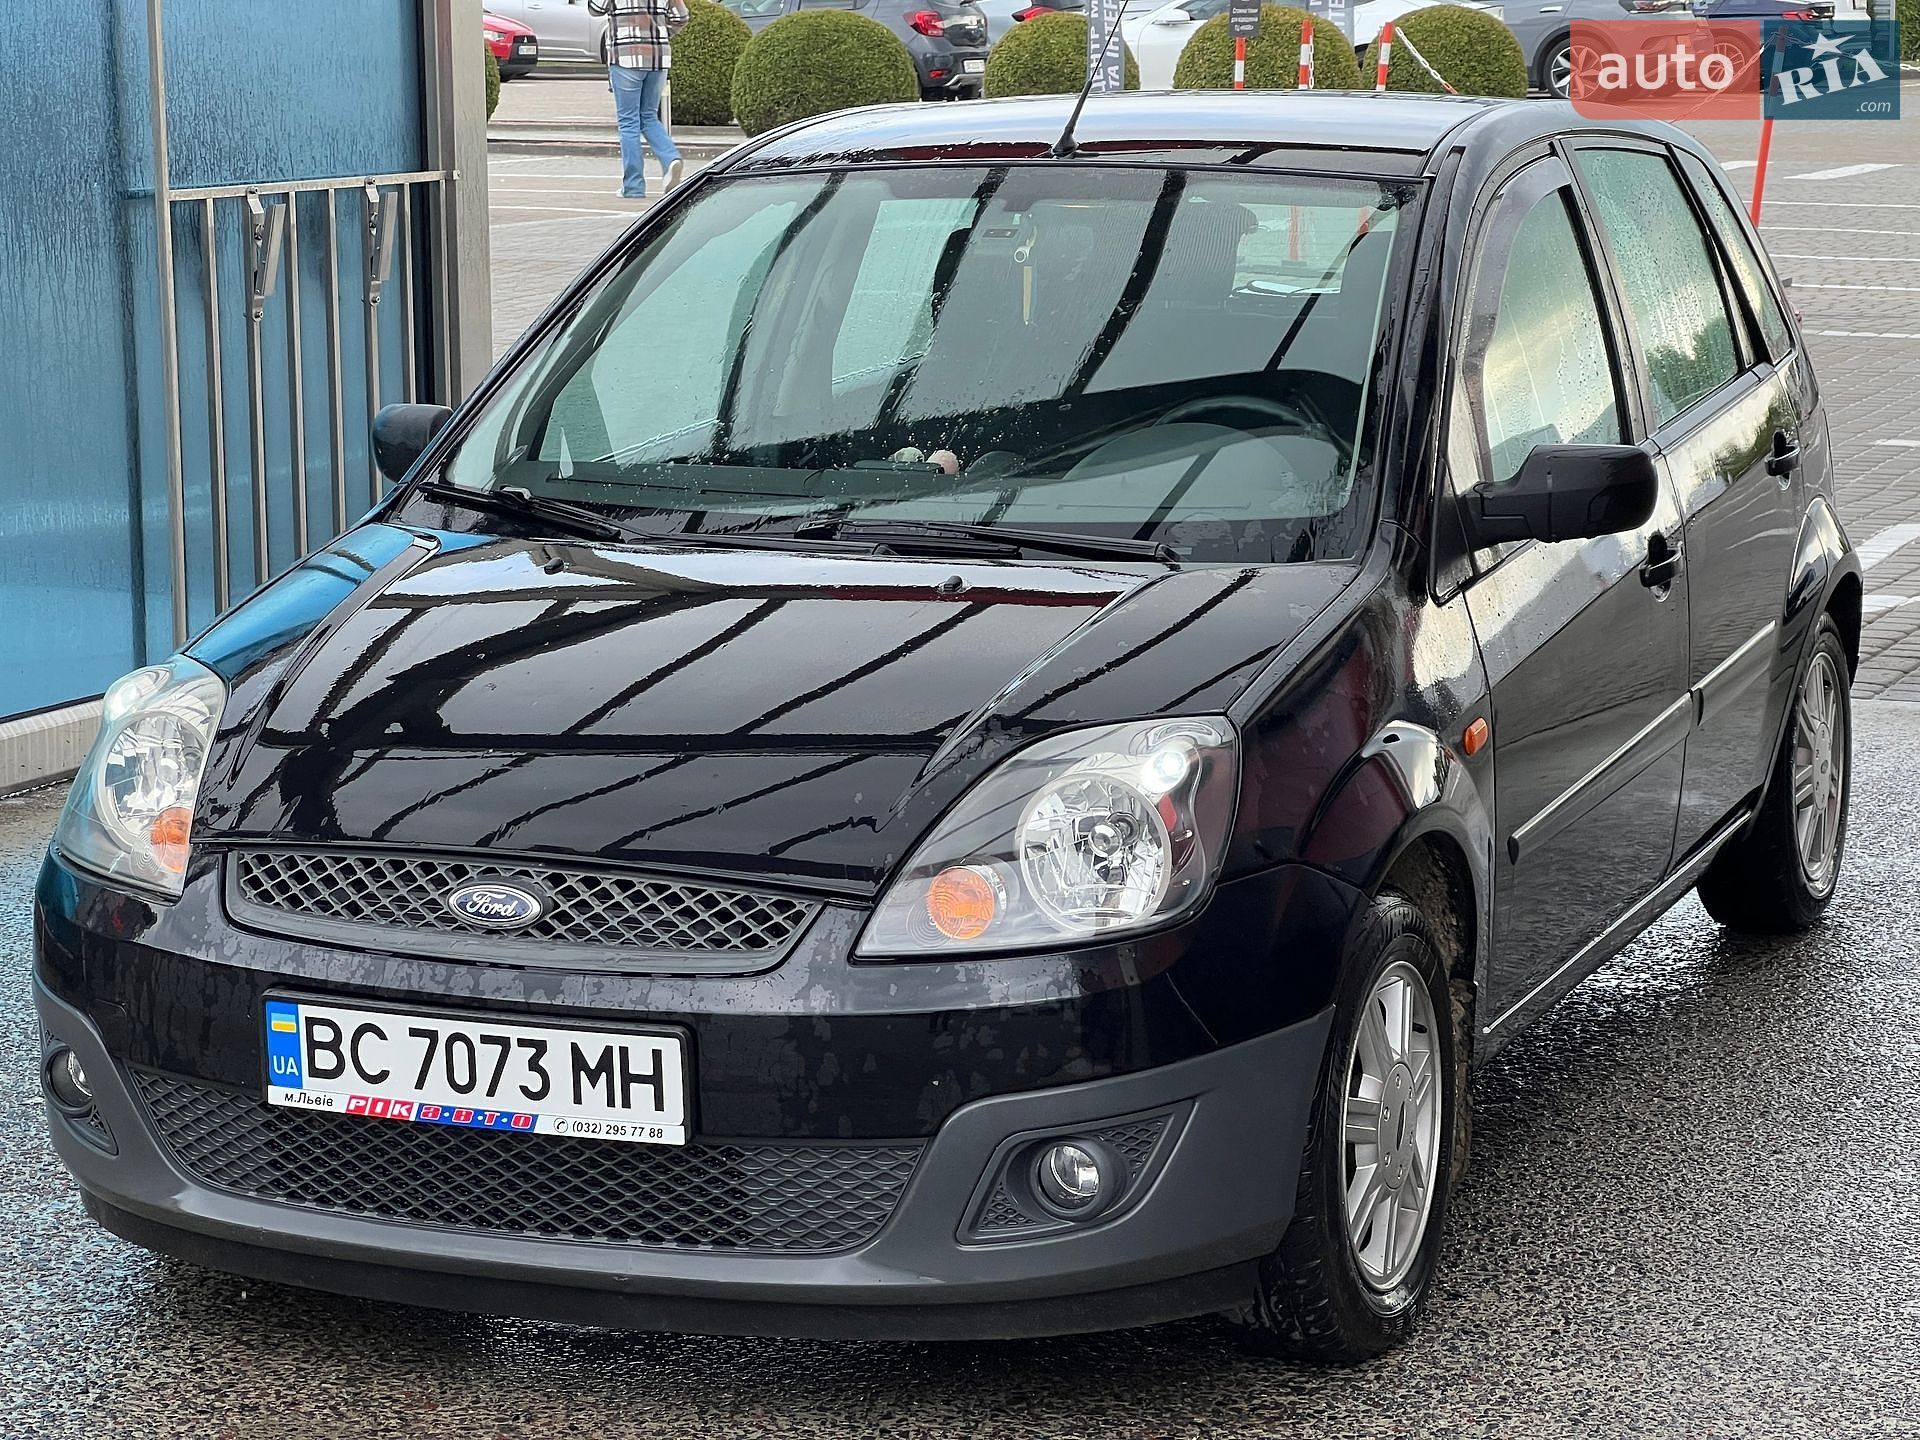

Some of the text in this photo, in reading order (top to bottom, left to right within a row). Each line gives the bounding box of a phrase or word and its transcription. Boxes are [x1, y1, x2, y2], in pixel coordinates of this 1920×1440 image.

[1107, 65, 1120, 89] ТА
[466, 891, 519, 917] Ford
[273, 1053, 299, 1077] UA
[304, 1015, 665, 1112] BC 7073 MH
[284, 1091, 334, 1107] м.Львів
[572, 1120, 663, 1139] (032) 295 77 88
